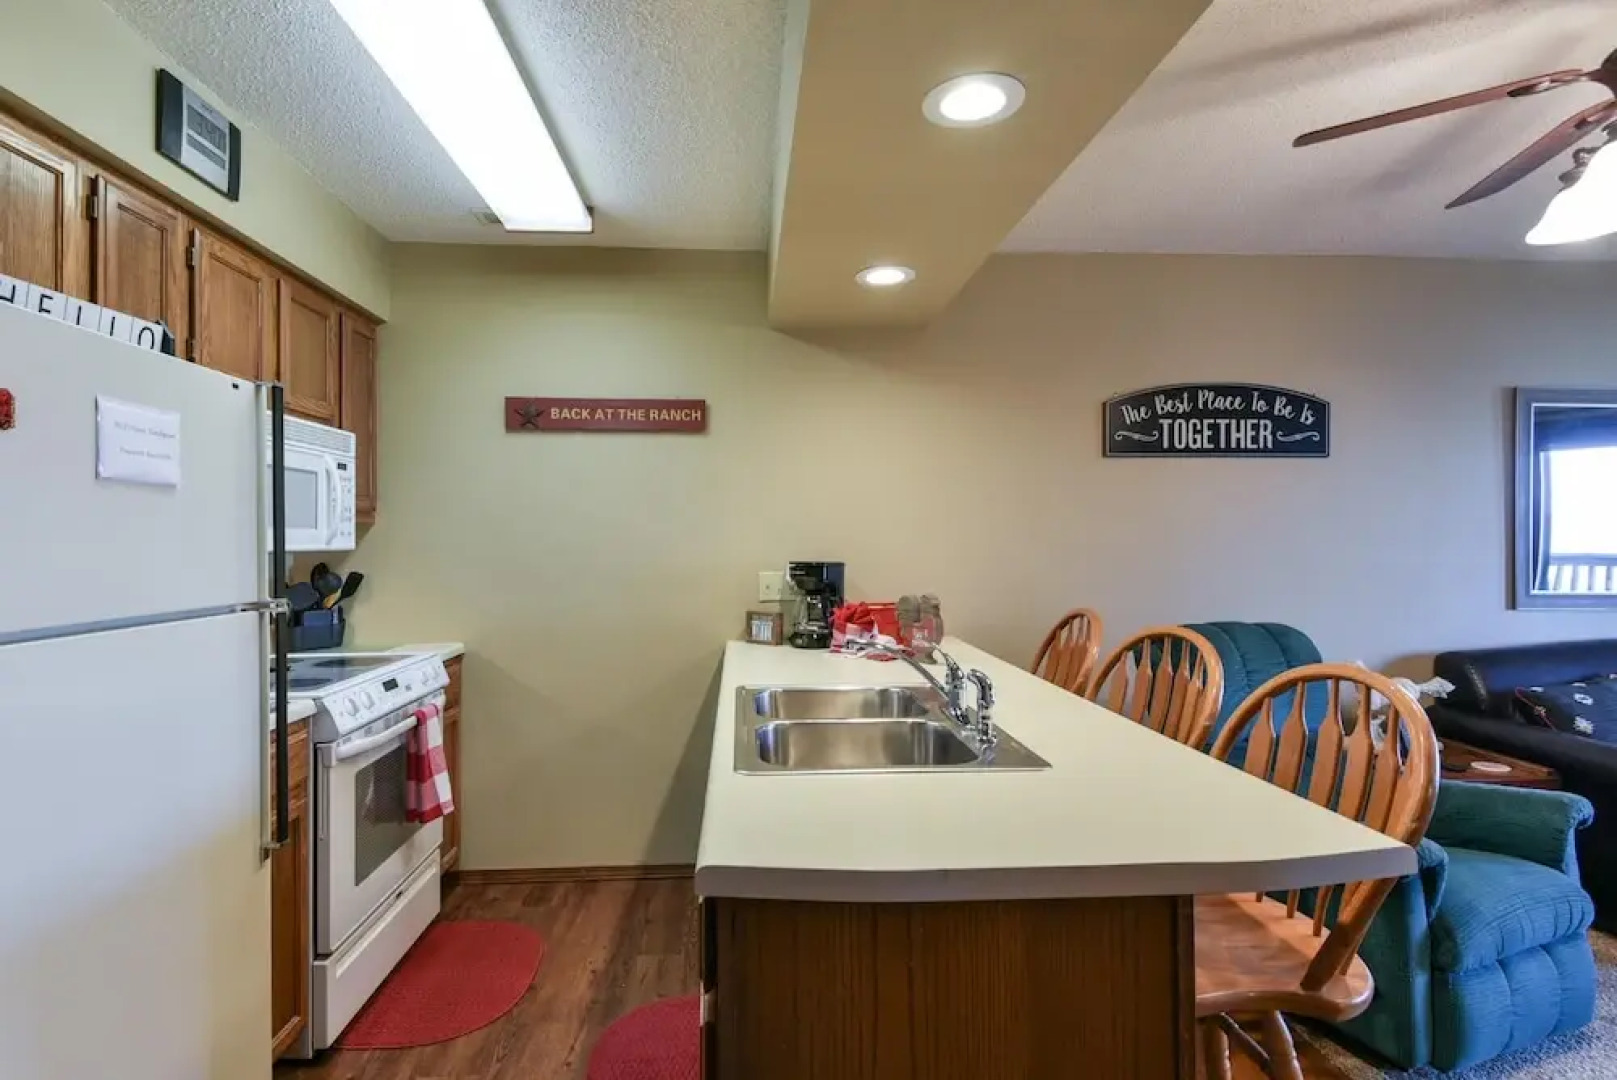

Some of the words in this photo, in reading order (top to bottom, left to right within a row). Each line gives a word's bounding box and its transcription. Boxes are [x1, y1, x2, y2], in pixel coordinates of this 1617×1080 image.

[550, 408, 591, 420] BACK
[594, 408, 613, 420] AT
[619, 408, 646, 421] THE
[649, 409, 701, 421] RANCH
[1120, 404, 1151, 425] The
[1154, 391, 1193, 415] Best
[1197, 388, 1246, 411] Place
[1251, 390, 1270, 412] To
[1273, 395, 1296, 418] Be
[1299, 402, 1317, 426] Is
[1158, 418, 1274, 449] TOGETHER
